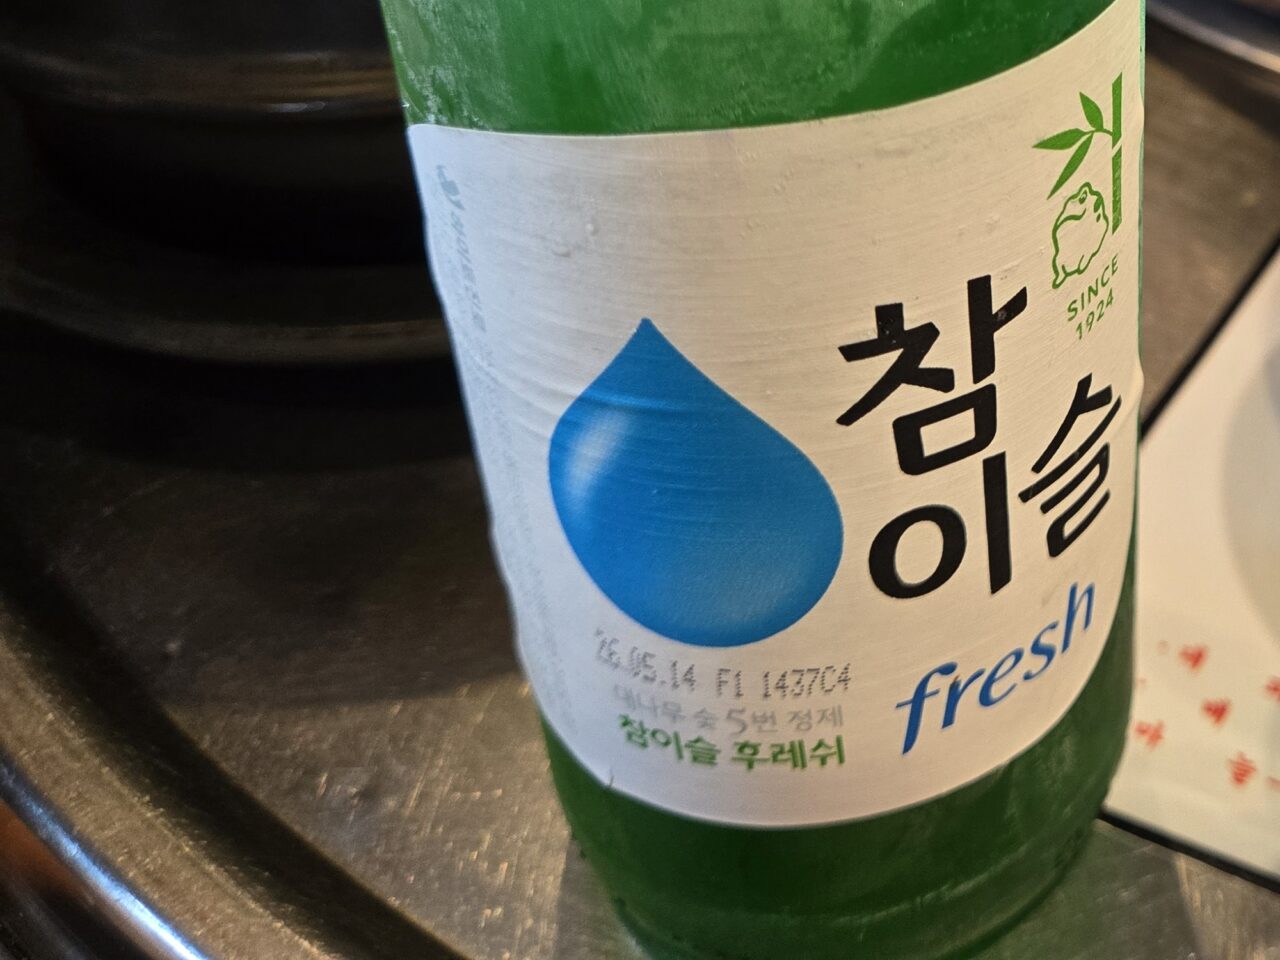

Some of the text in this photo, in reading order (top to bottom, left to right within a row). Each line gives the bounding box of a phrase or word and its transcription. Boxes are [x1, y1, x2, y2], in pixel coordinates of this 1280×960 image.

[1066, 253, 1120, 321] SINCE
[1075, 287, 1115, 340] 1924
[718, 667, 744, 698] F1
[762, 662, 852, 699] 1437C4
[896, 581, 1096, 757] fresh
[618, 713, 846, 771] 참이슬 후레쉬
[787, 704, 845, 732] 정제
